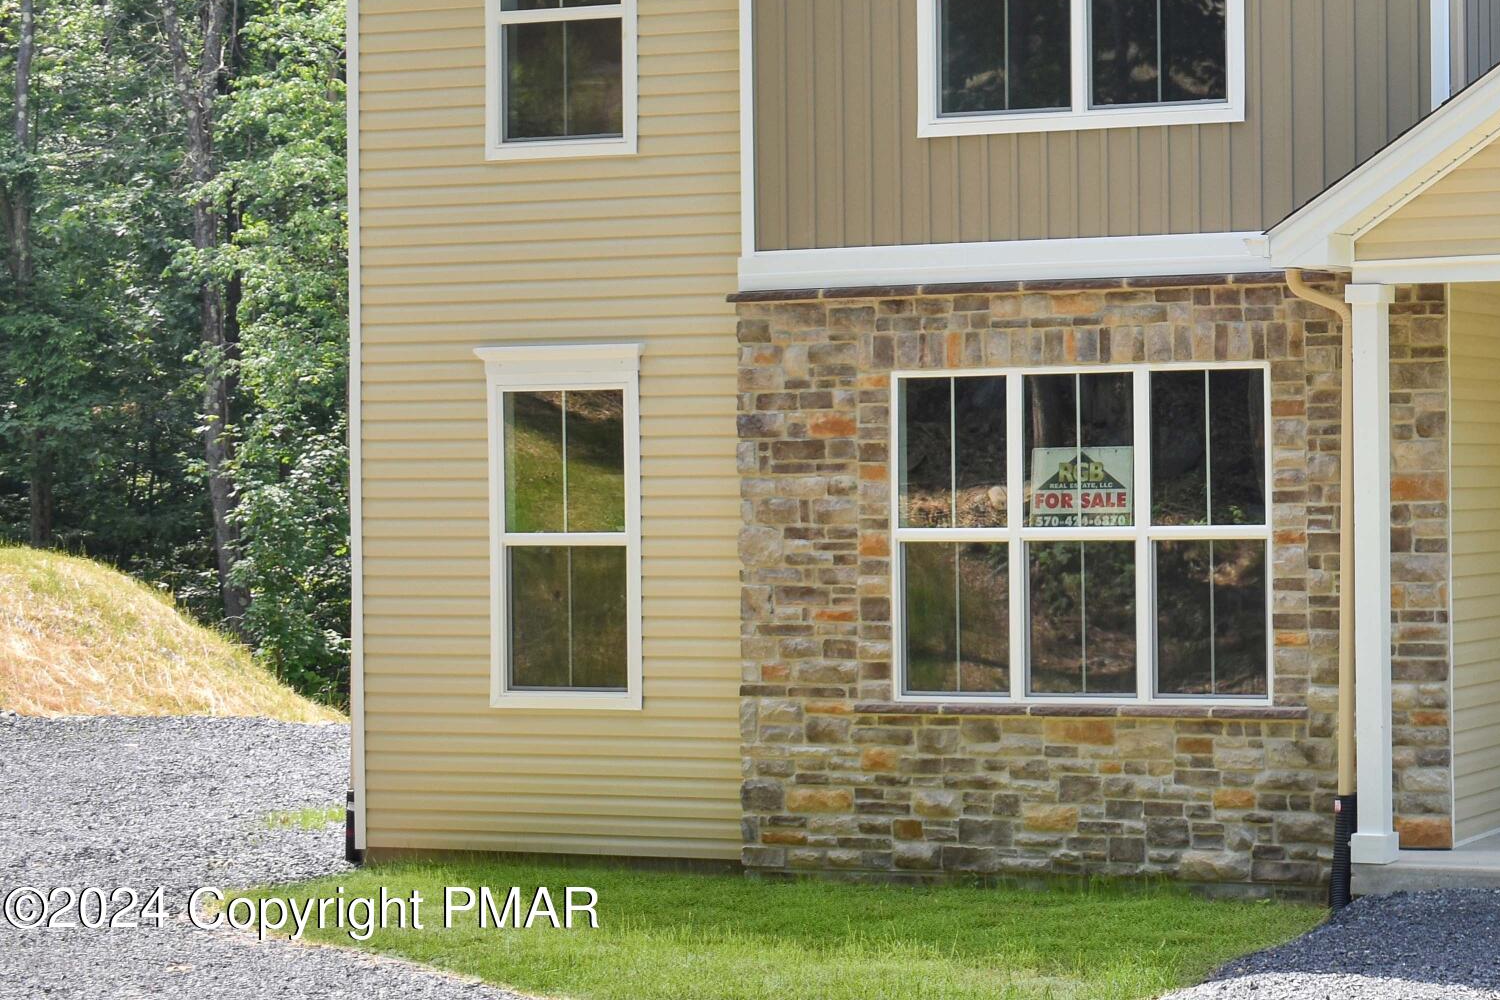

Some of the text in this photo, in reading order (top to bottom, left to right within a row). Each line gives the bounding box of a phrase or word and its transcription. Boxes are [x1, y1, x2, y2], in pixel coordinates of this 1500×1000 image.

[1058, 461, 1105, 483] RGB
[1035, 491, 1127, 509] FOR SALE
